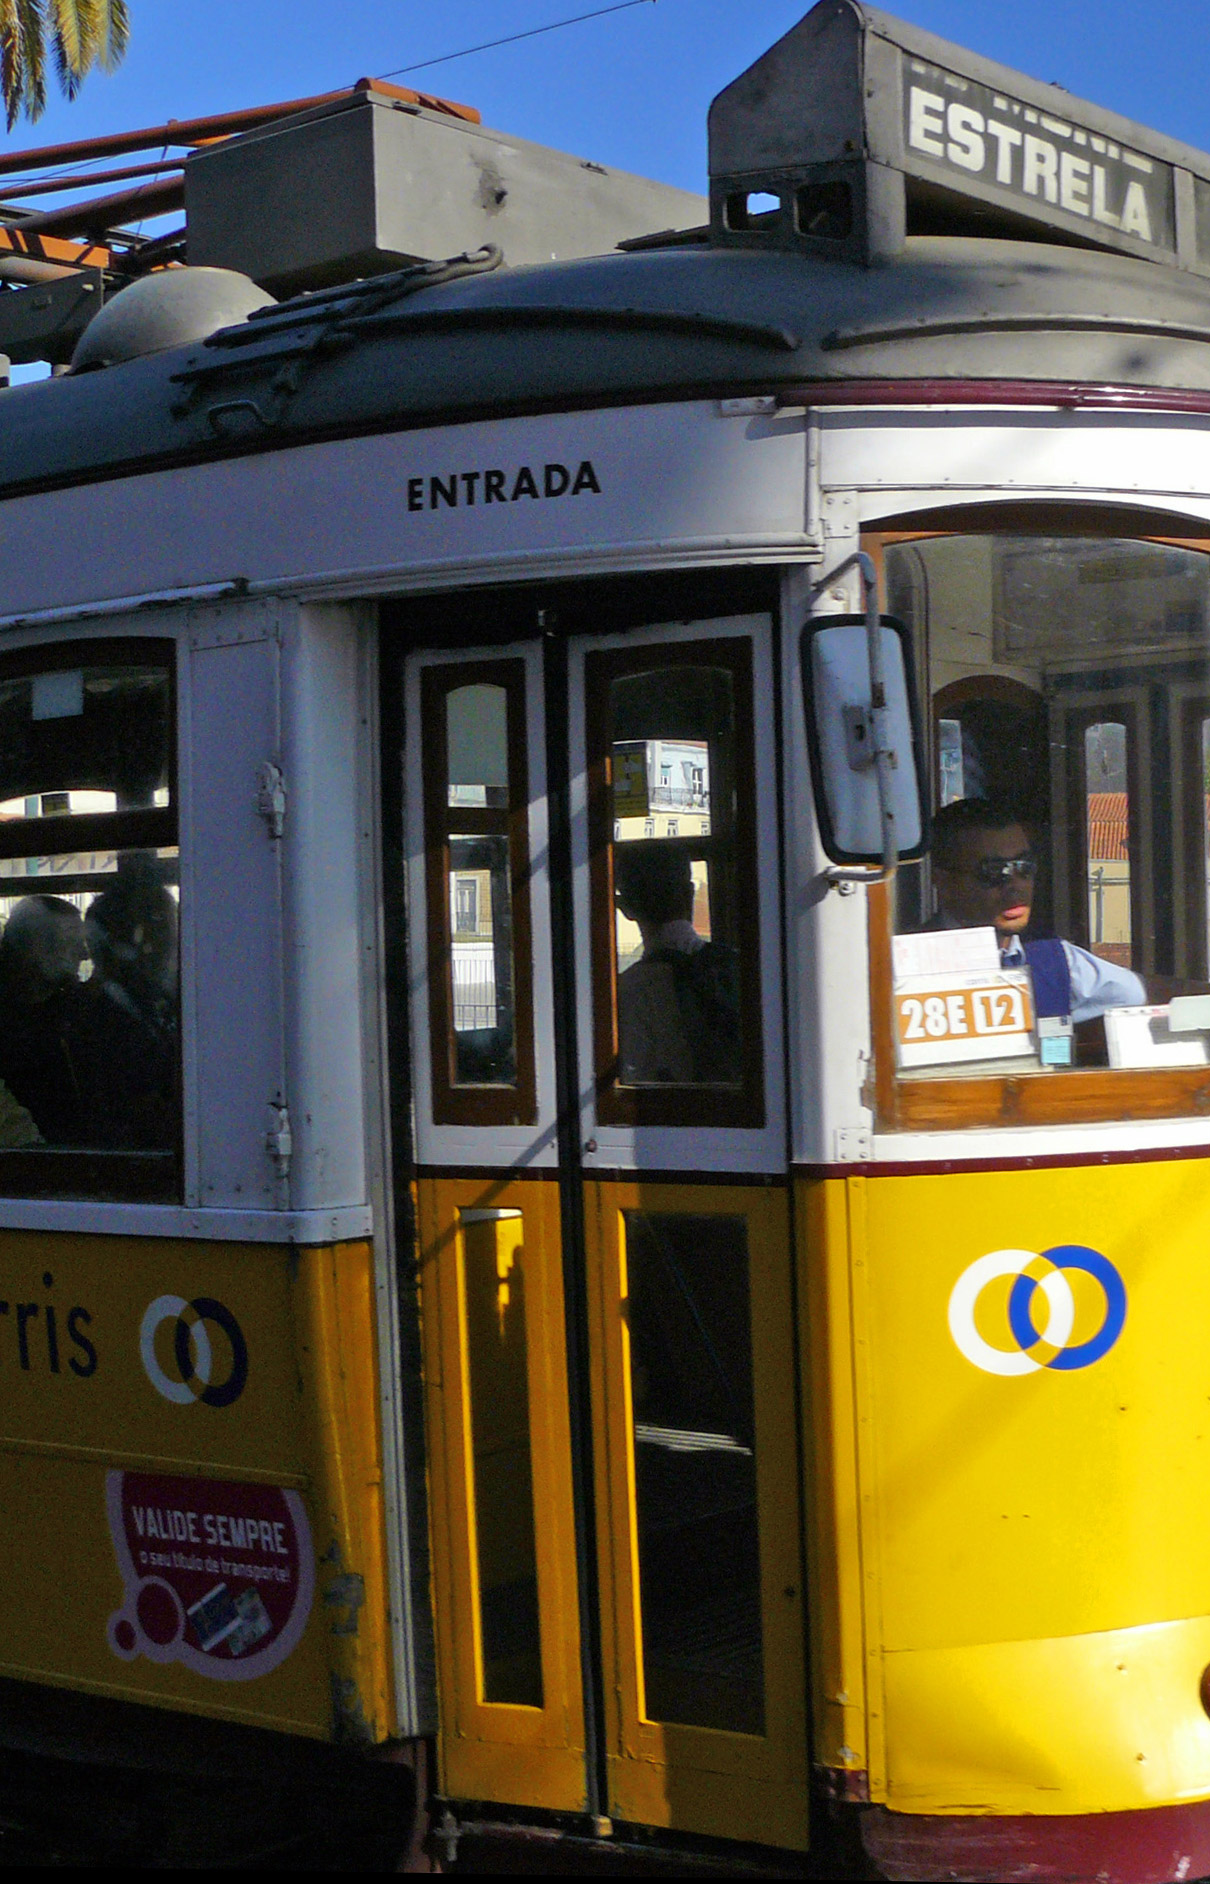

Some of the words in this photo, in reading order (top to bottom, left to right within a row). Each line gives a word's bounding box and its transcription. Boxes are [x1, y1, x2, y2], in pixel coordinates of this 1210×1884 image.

[908, 85, 1153, 242] ESTRELA
[407, 460, 602, 512] ENTRADA
[901, 995, 968, 1039] 28E
[980, 993, 1016, 1027] 12
[131, 1505, 201, 1543] VALIDE
[203, 1513, 289, 1554] SEMPRE
